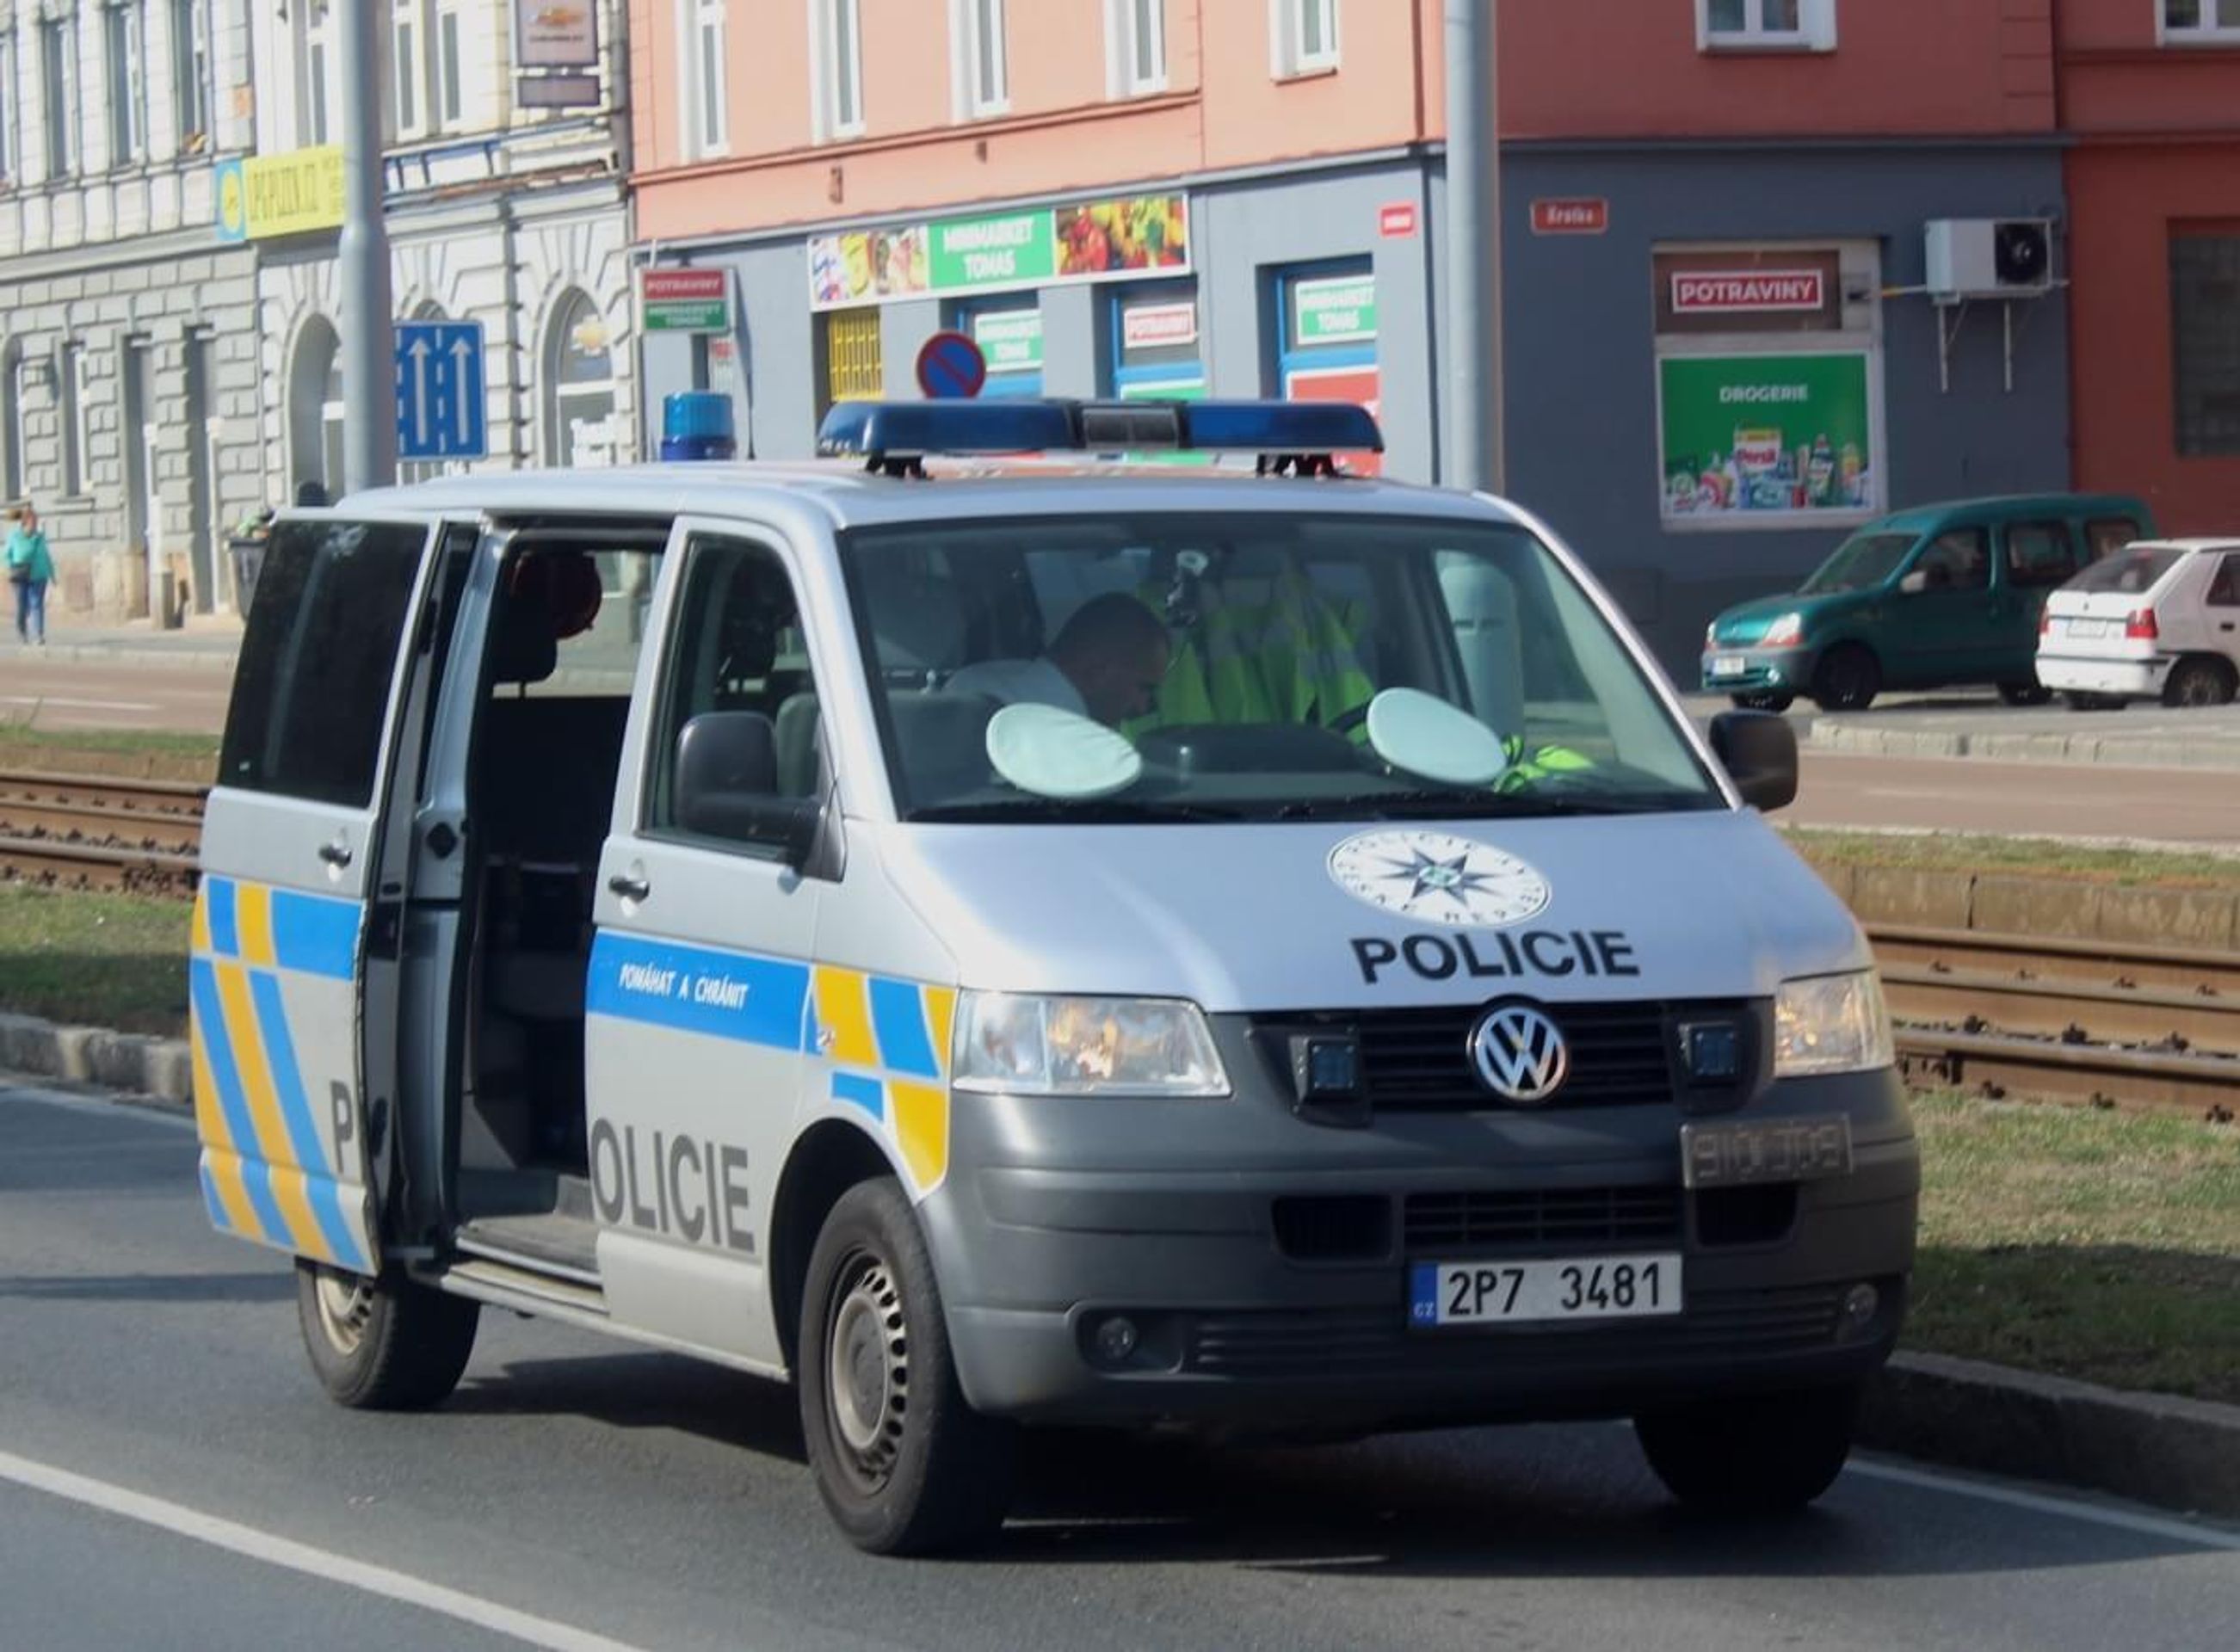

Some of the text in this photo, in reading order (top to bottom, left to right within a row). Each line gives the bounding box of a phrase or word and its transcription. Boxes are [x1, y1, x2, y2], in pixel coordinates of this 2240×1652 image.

[943, 215, 1035, 254] MINIMARKET
[1681, 280, 1813, 303] POTRAVINY
[1719, 384, 1809, 404] DROGERIE
[1350, 929, 1641, 985] POLICIE
[676, 973, 690, 1002] A
[330, 1080, 354, 1174] P
[1447, 1261, 1662, 1317] 2P7 3481
[1413, 1302, 1435, 1318] CZ
